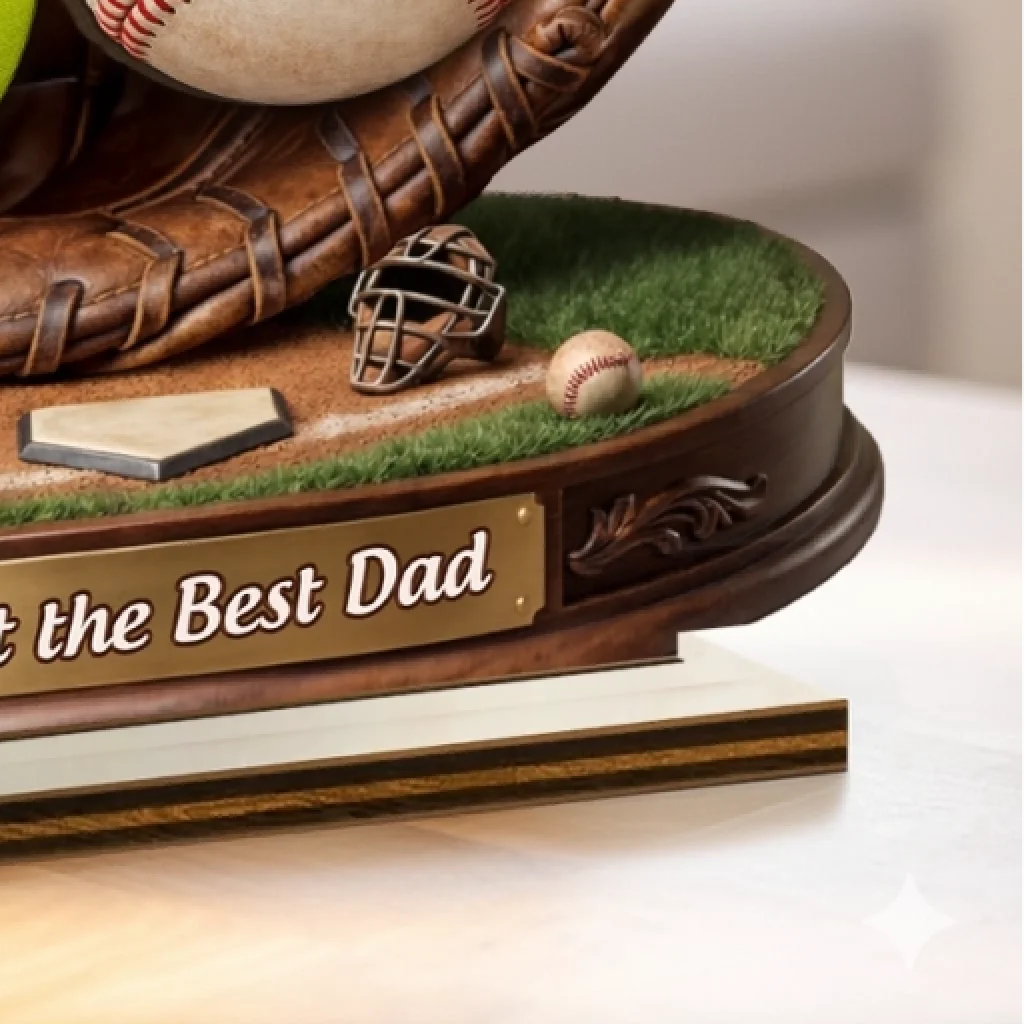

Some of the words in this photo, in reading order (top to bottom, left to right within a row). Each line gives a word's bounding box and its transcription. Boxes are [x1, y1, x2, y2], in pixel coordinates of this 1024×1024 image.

[34, 591, 152, 663] the
[171, 565, 326, 647] Best
[343, 528, 495, 619] Dad
